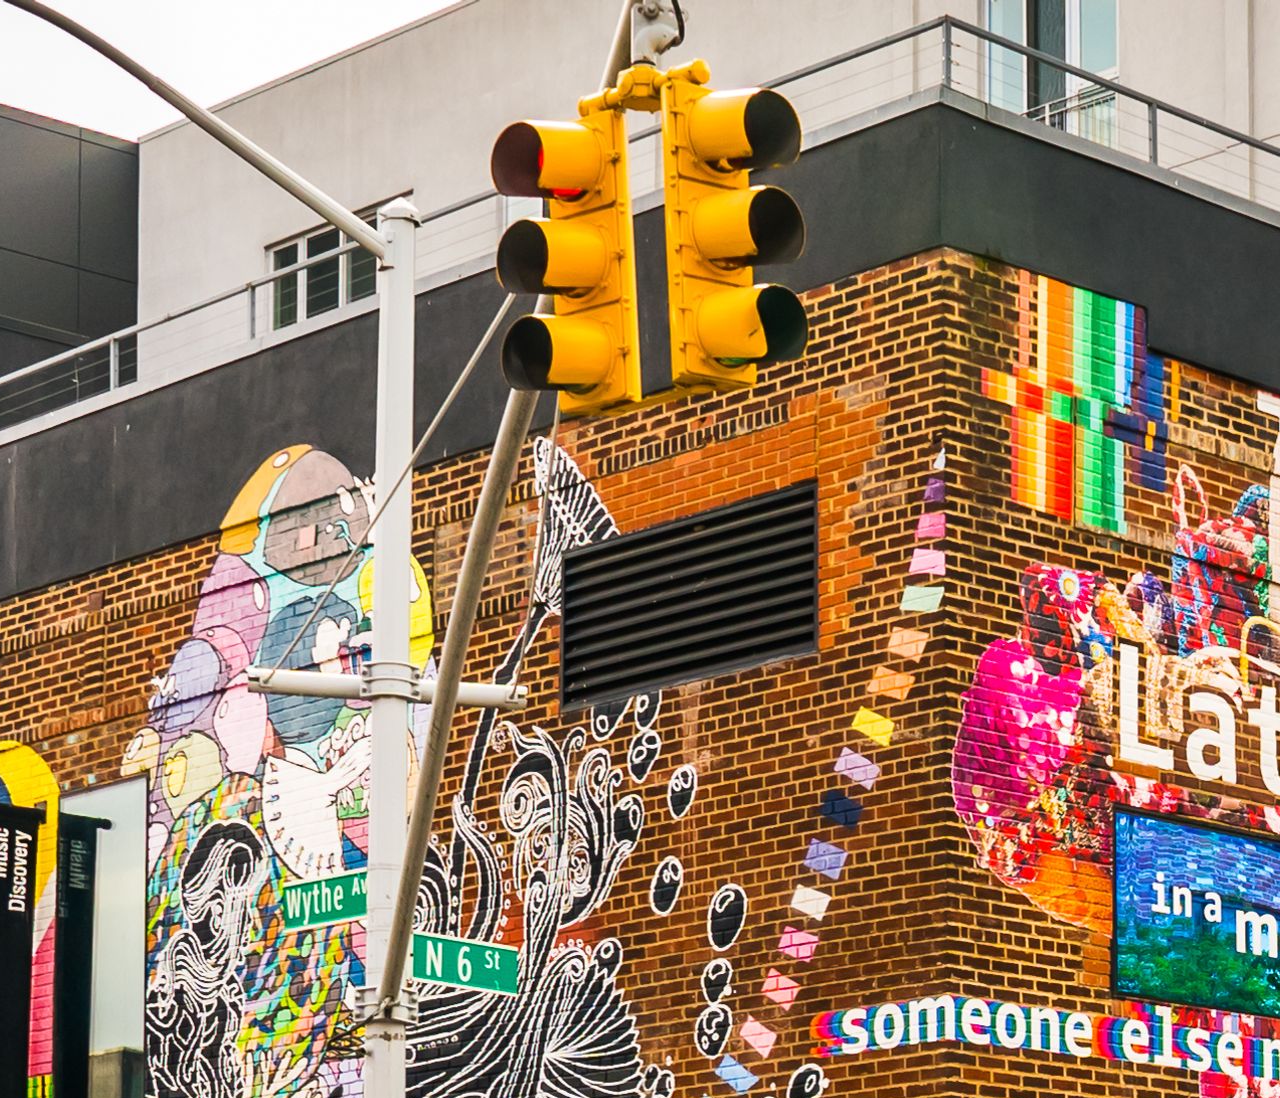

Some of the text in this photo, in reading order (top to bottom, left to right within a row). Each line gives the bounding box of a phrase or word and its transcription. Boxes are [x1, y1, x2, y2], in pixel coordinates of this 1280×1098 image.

[8, 829, 32, 913] Discovery
[286, 885, 344, 926] Wythe
[1152, 874, 1193, 919] in
[1203, 890, 1223, 923] a
[426, 940, 501, 983] N 6 St
[841, 994, 1094, 1058] someone
[1122, 999, 1243, 1070] else
